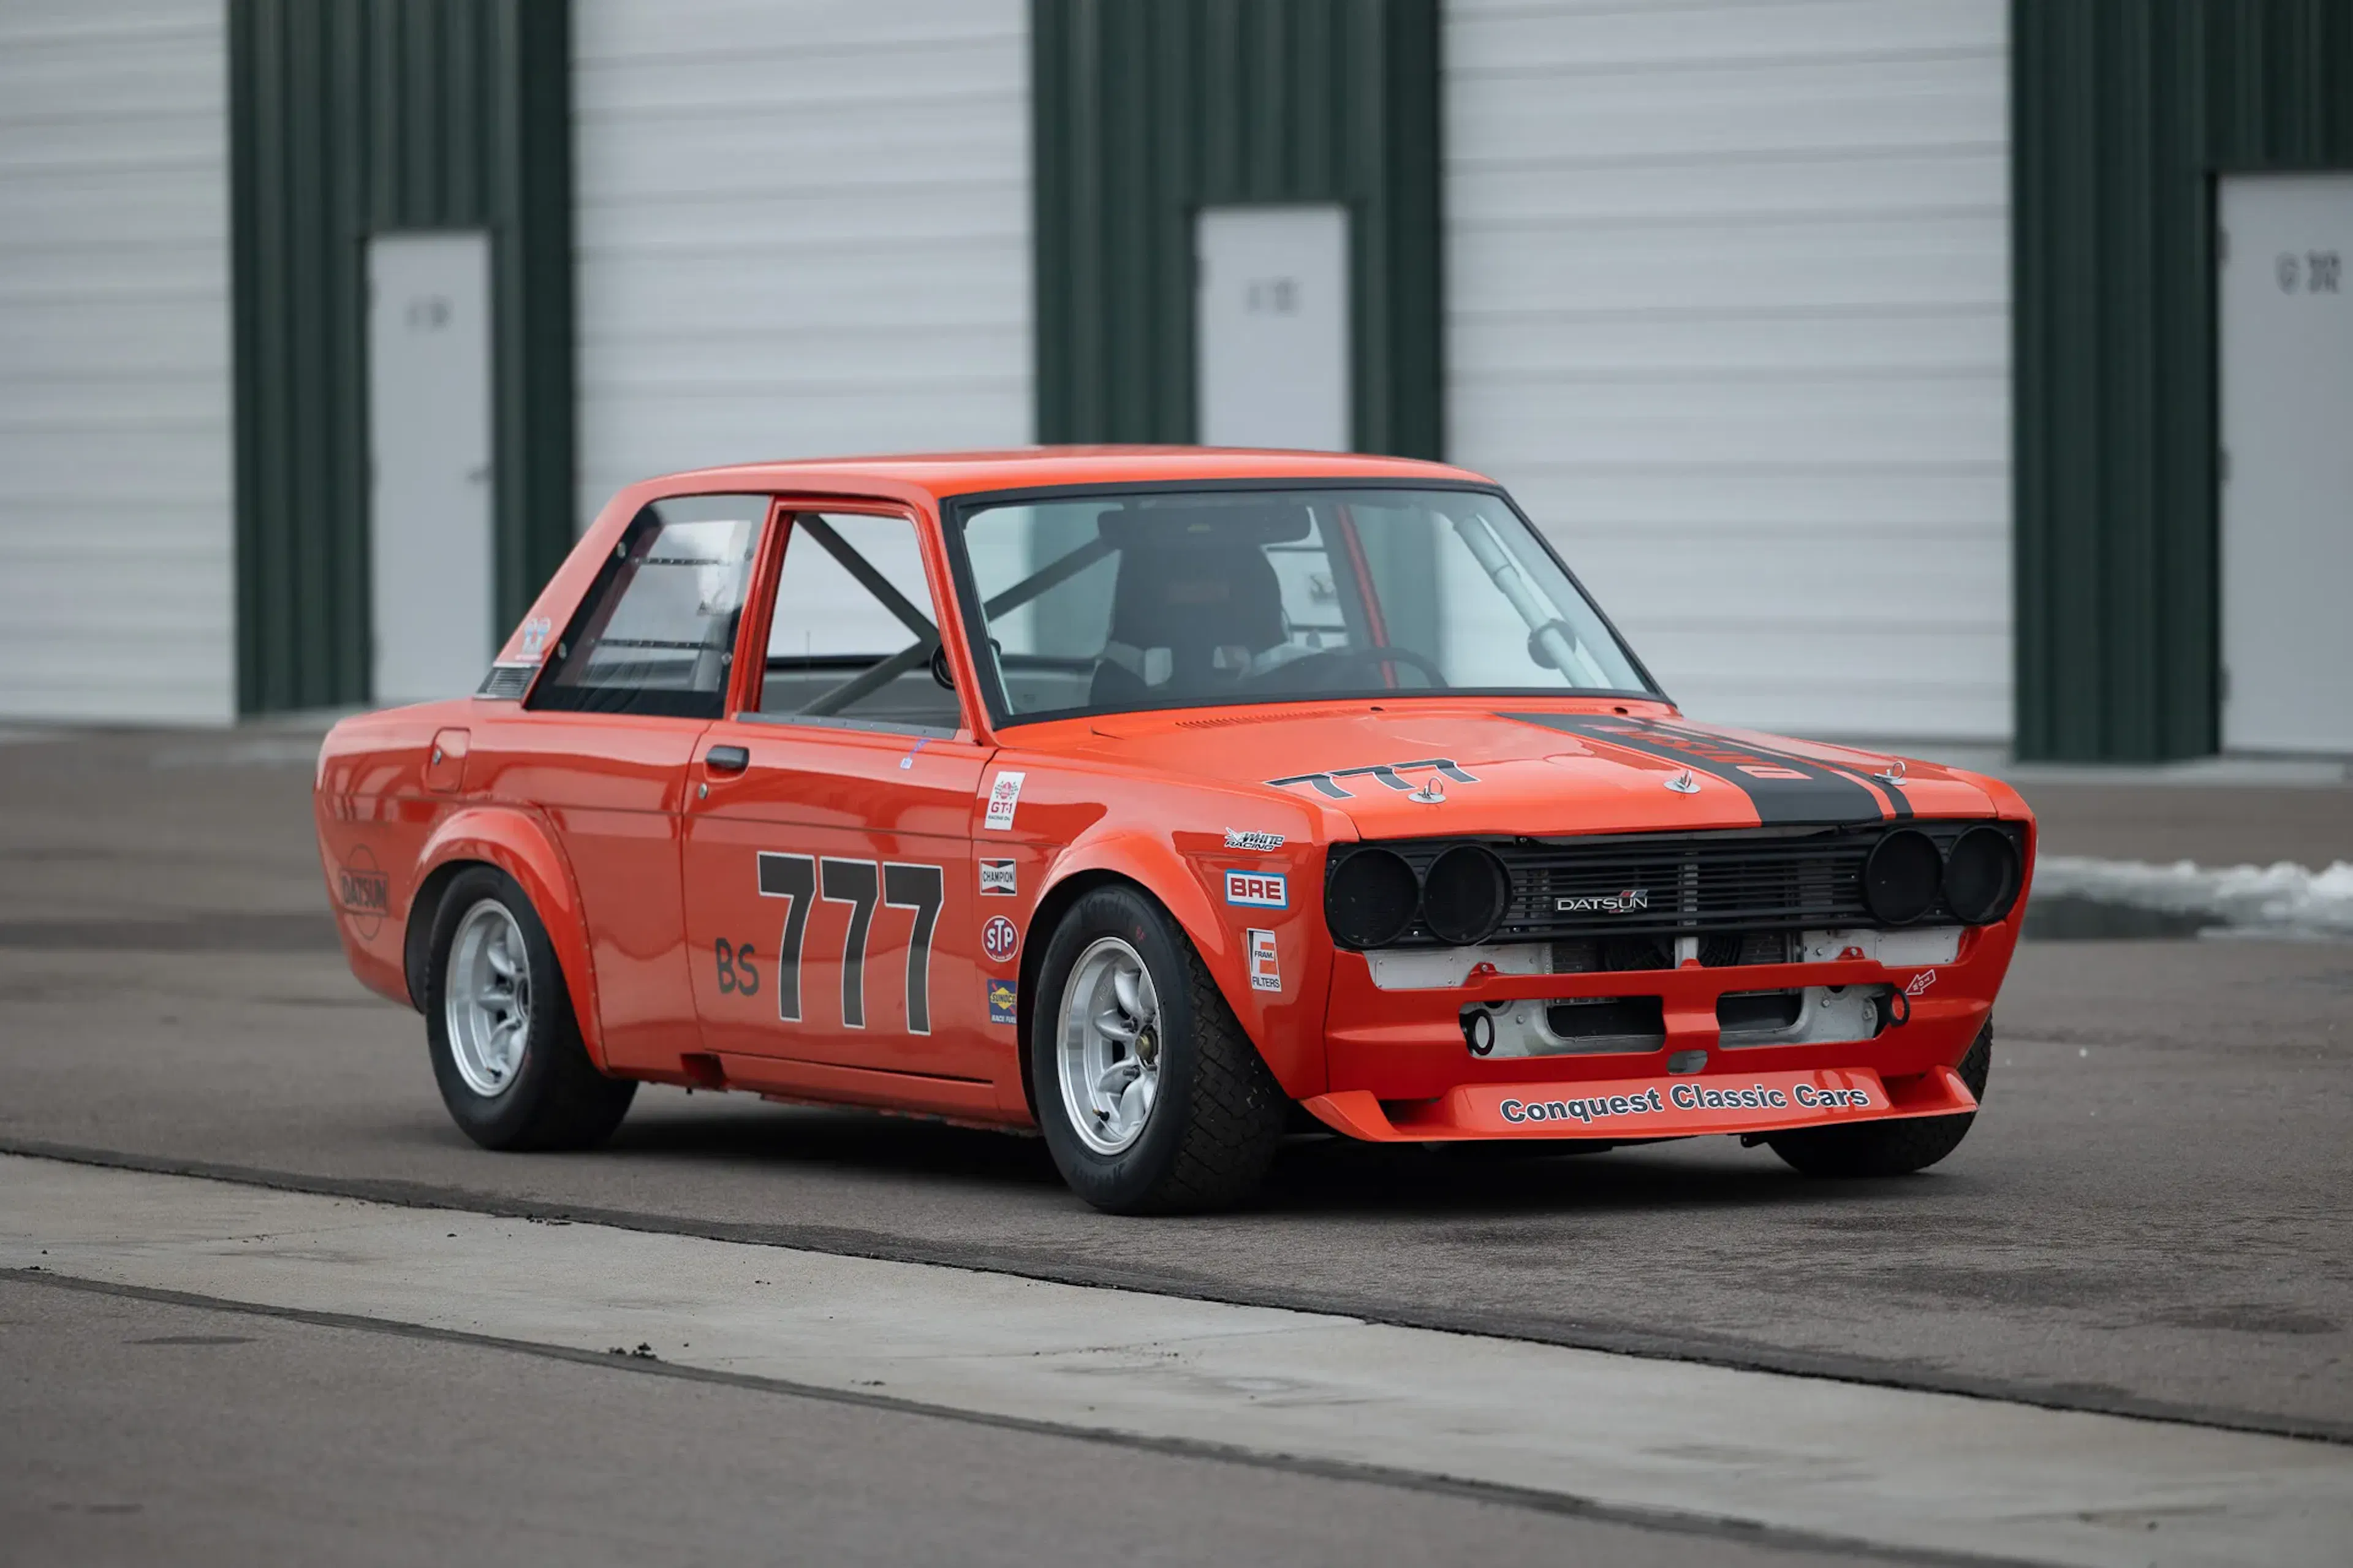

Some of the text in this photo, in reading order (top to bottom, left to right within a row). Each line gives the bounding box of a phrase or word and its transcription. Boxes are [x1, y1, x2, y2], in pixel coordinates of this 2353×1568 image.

[1262, 757, 1482, 800] 777
[1226, 840, 1273, 850] RACING
[1243, 833, 1284, 846] WHITE
[983, 871, 1014, 882] CHAMPION
[1230, 877, 1281, 900] BRE
[1557, 897, 1648, 911] DATSUN
[757, 850, 944, 1036] 777
[987, 920, 1014, 952] STP
[715, 937, 759, 996] BS
[1252, 976, 1280, 988] FILTERS
[1912, 975, 1930, 991] TOW
[1501, 1083, 1871, 1124] Conquest Classic Cars
